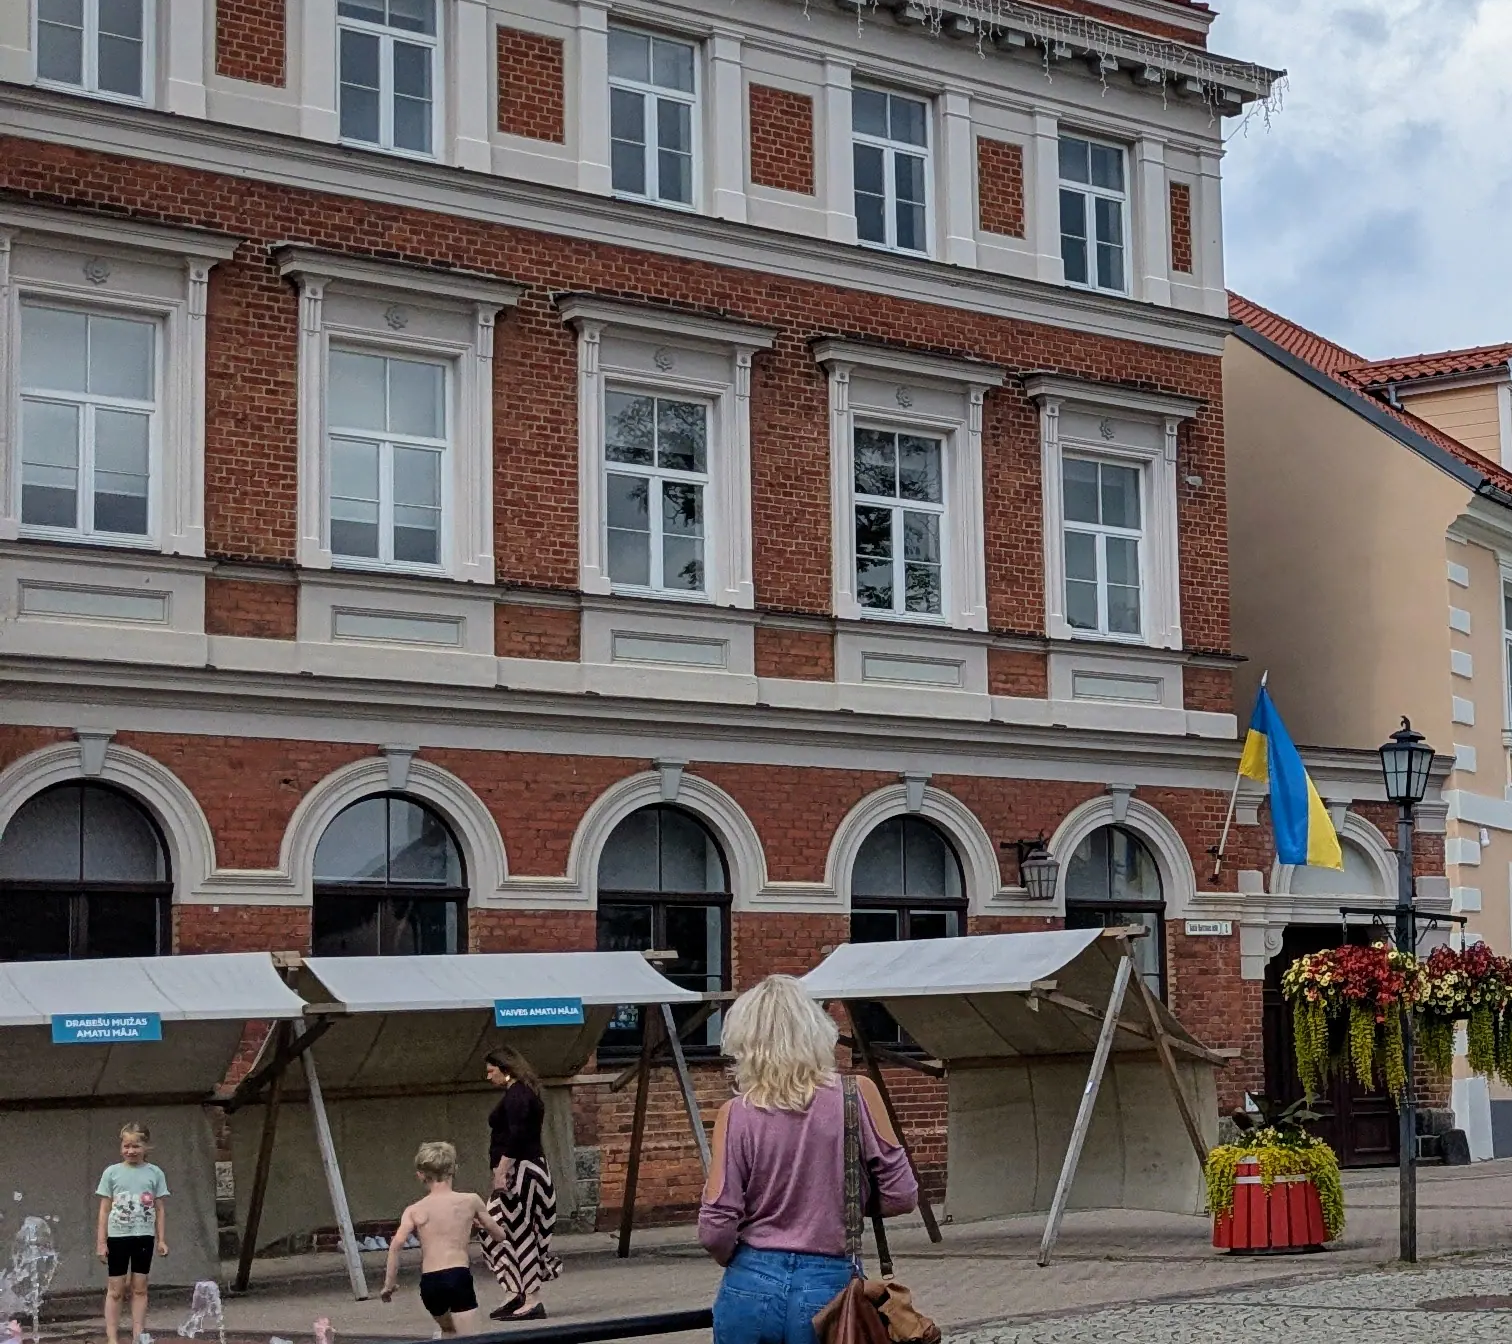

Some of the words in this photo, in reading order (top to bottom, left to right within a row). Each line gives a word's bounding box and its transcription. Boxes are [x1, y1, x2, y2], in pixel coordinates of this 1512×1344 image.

[500, 1008, 528, 1016] VAIVES
[529, 1007, 557, 1016] AMATU
[557, 1006, 579, 1015] MĀJA
[65, 1018, 110, 1028] DRABEŠU
[111, 1017, 148, 1027] MUIŽAS
[76, 1029, 111, 1038] AMATU
[112, 1028, 139, 1037] MĀJA
